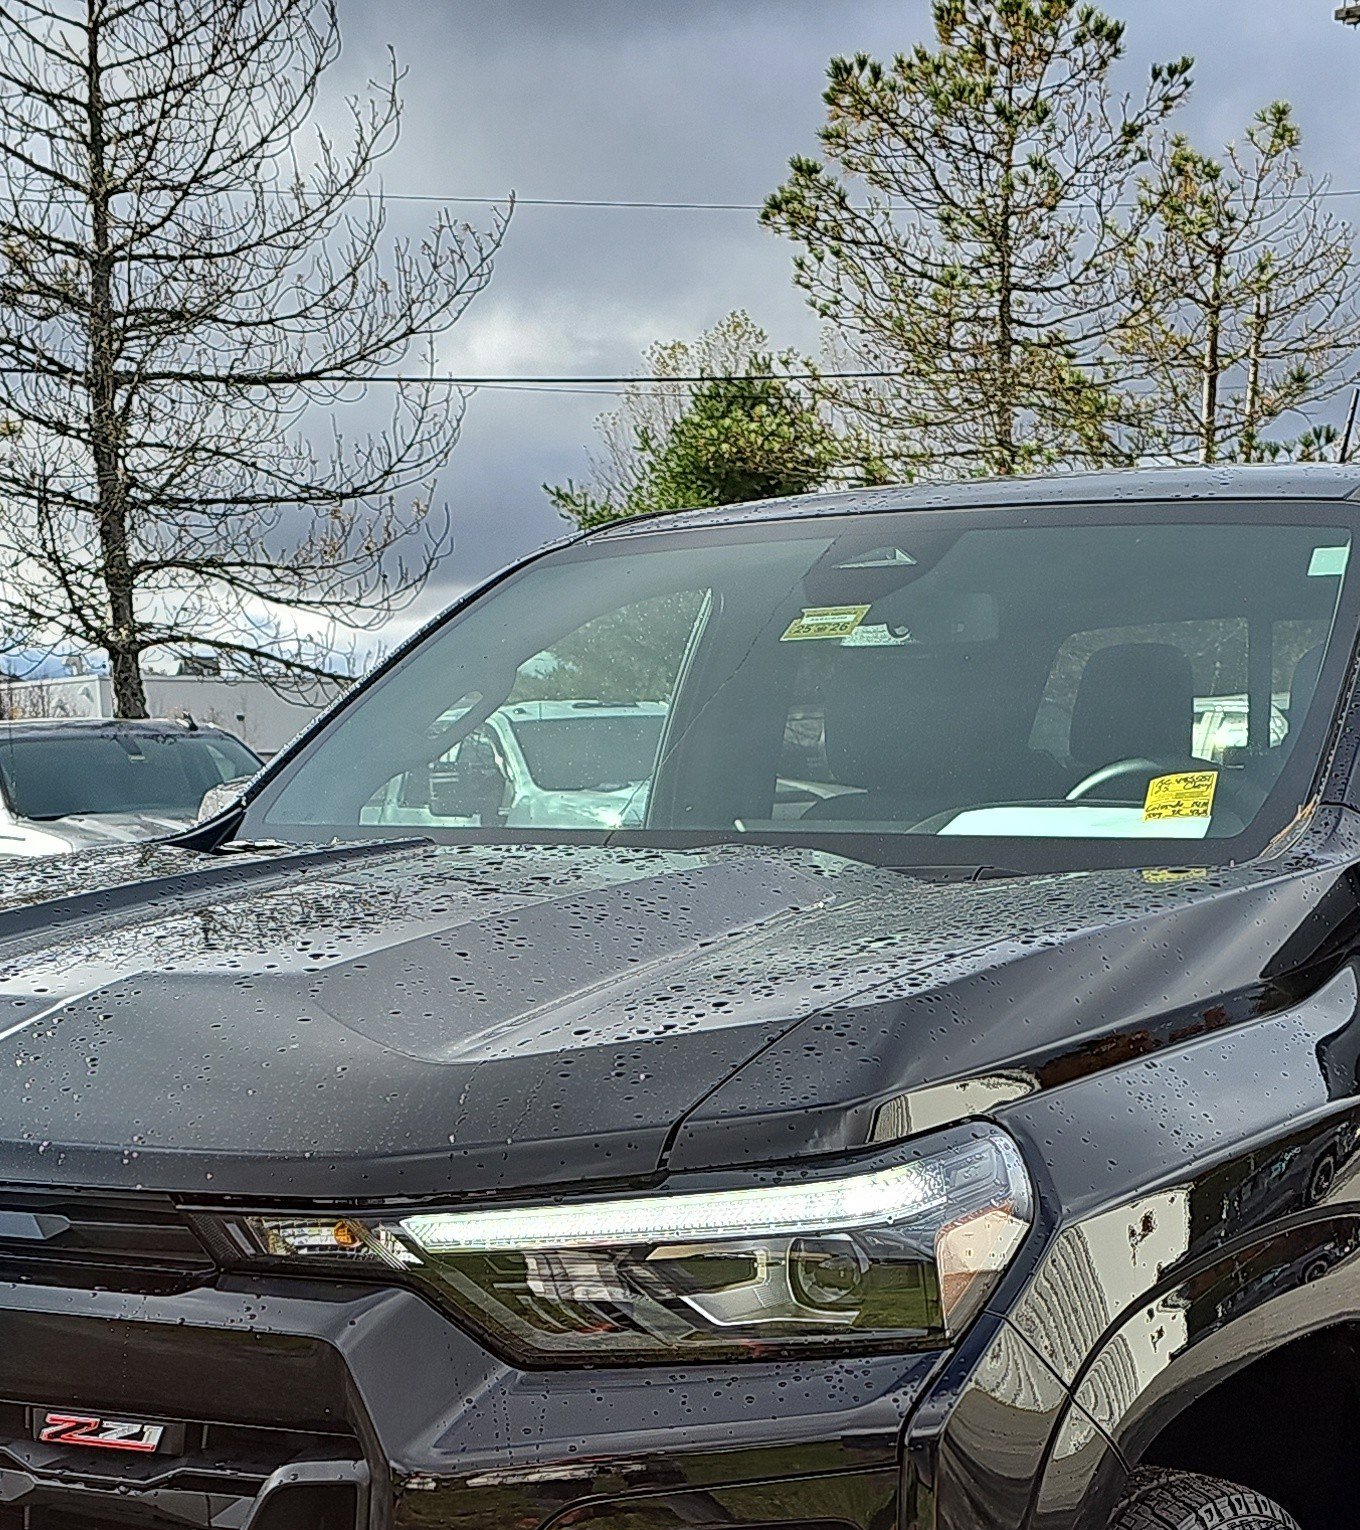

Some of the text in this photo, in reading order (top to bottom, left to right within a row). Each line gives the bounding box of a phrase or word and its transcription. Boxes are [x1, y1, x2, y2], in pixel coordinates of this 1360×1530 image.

[793, 624, 812, 634] 25
[829, 622, 849, 632] 26
[40, 1412, 163, 1452] Z71
